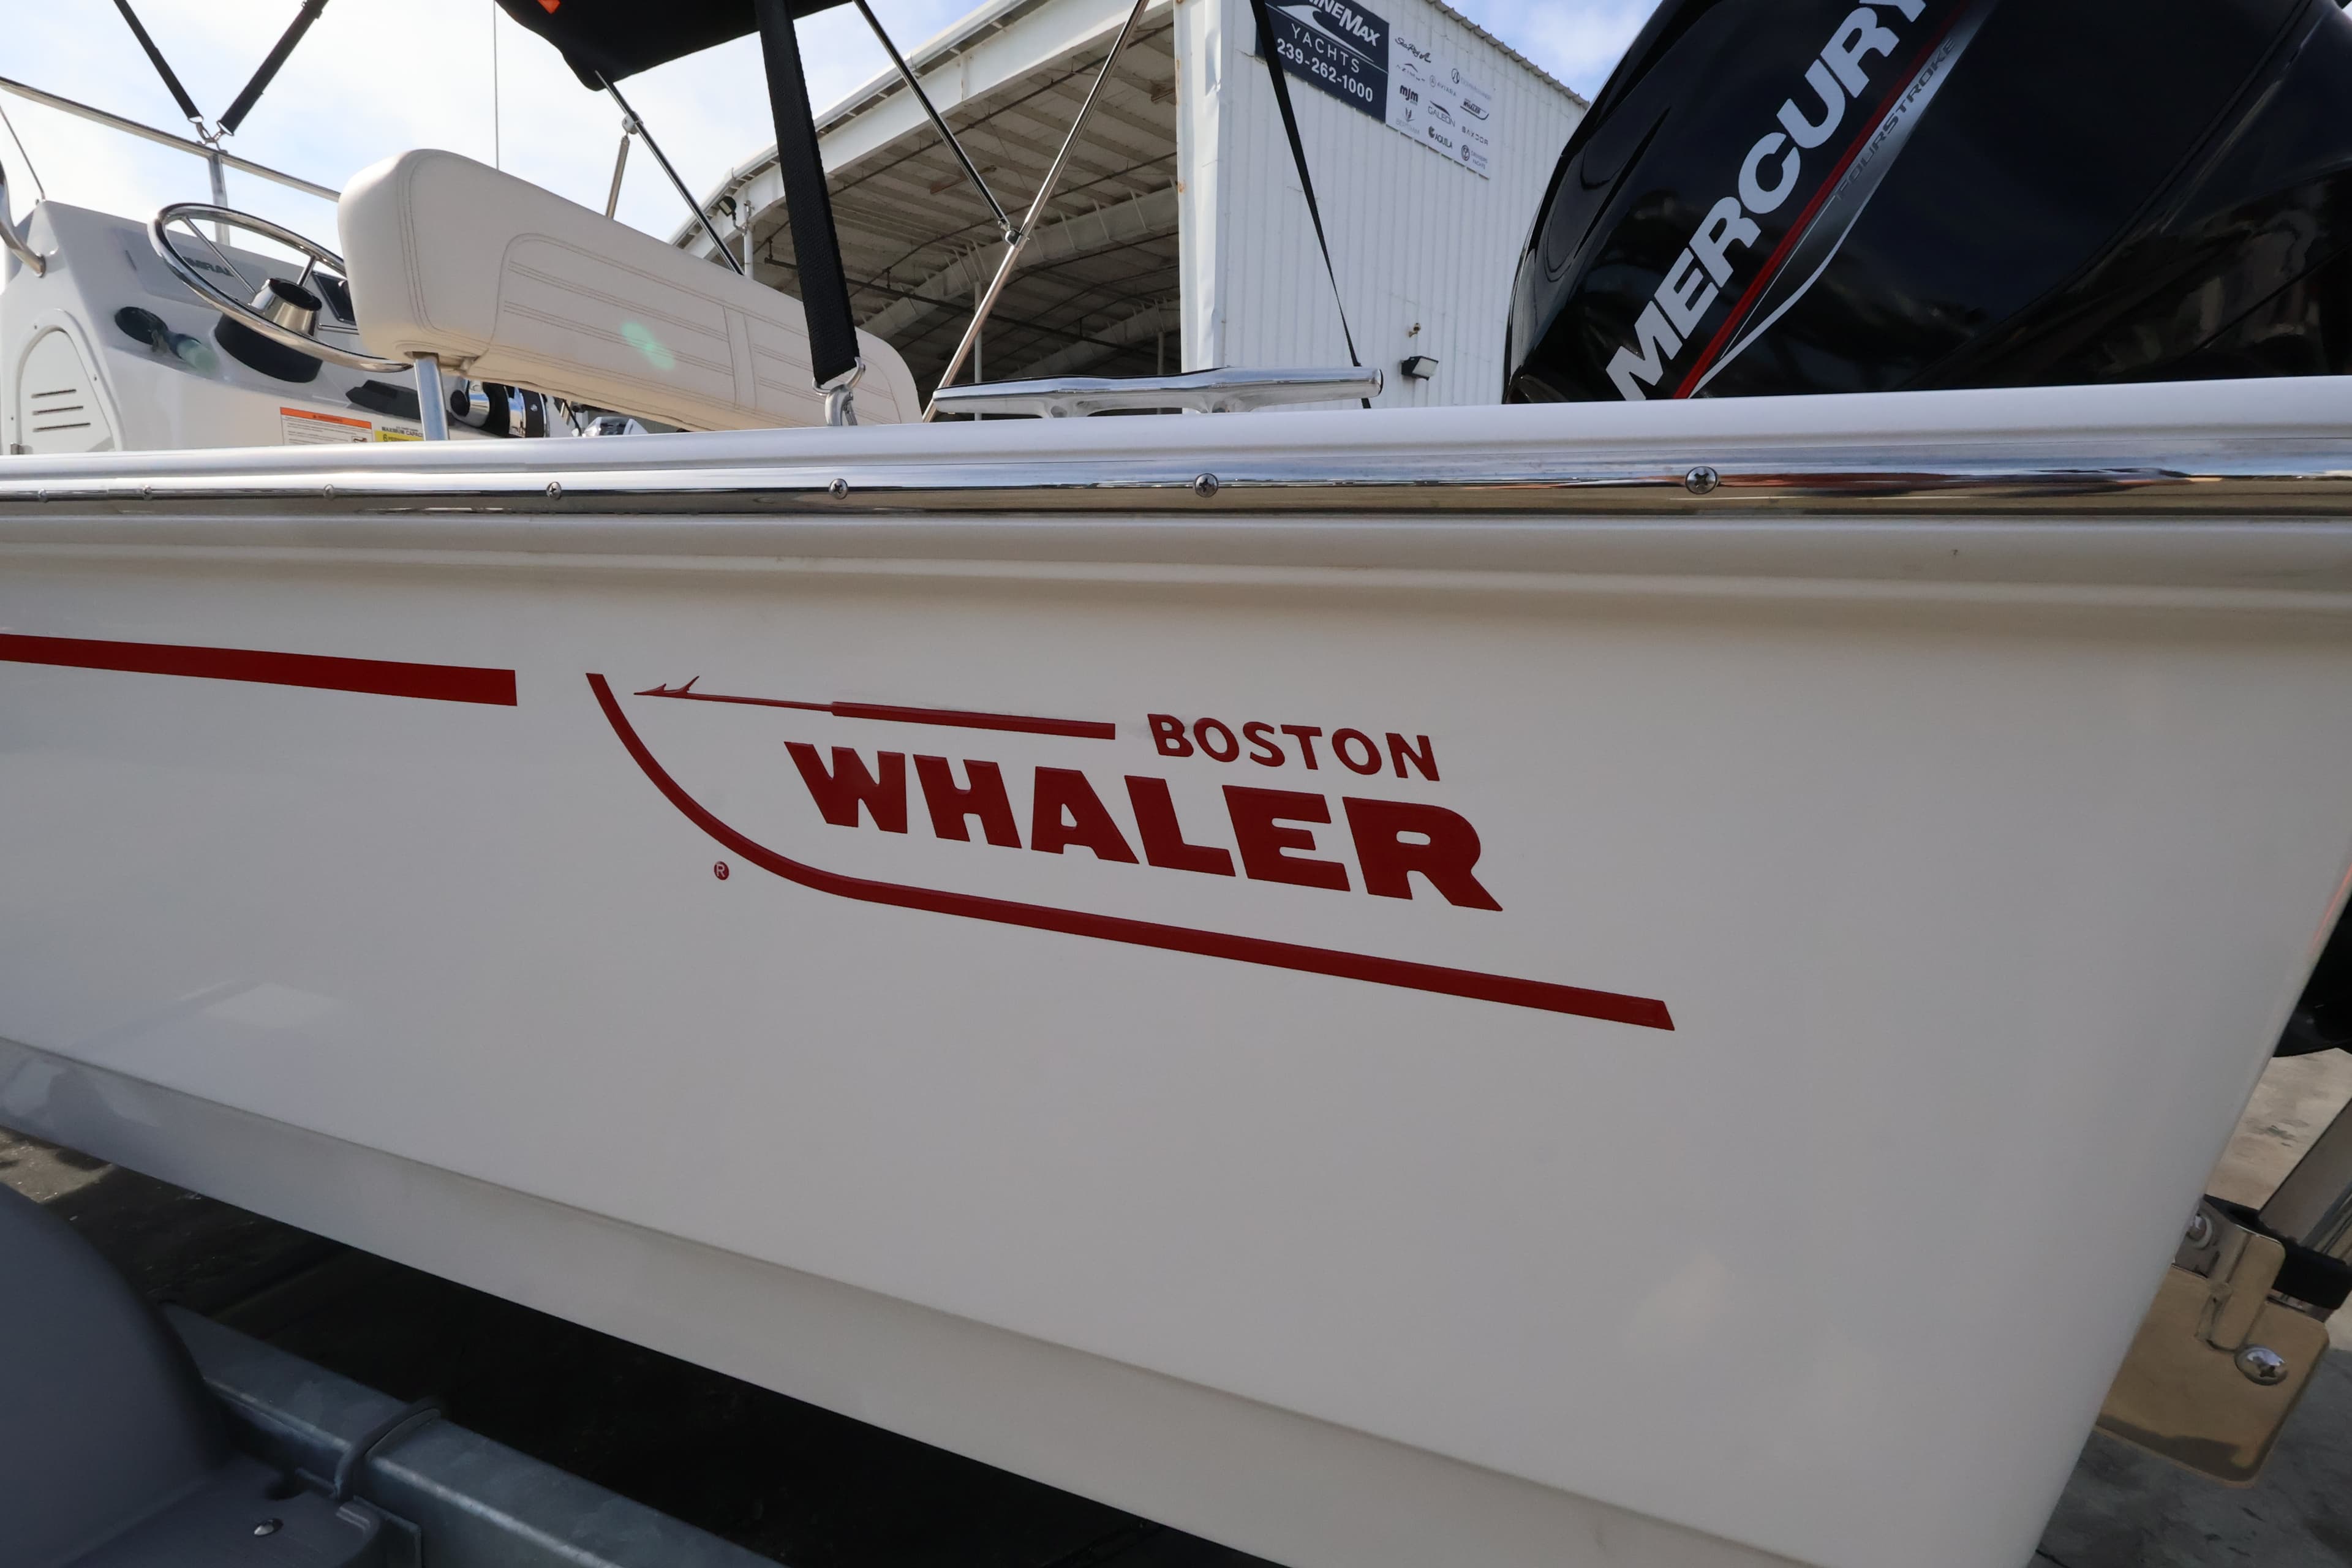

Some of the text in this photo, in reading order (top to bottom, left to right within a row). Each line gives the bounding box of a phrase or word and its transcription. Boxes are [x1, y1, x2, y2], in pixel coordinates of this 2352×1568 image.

[1277, 38, 1373, 102] 239-262-1000
[1291, 23, 1360, 74] YACHTS
[1834, 37, 1956, 201] FOURSTROKE
[1147, 713, 1440, 782] BOSTON
[783, 741, 1503, 913] WHALER
